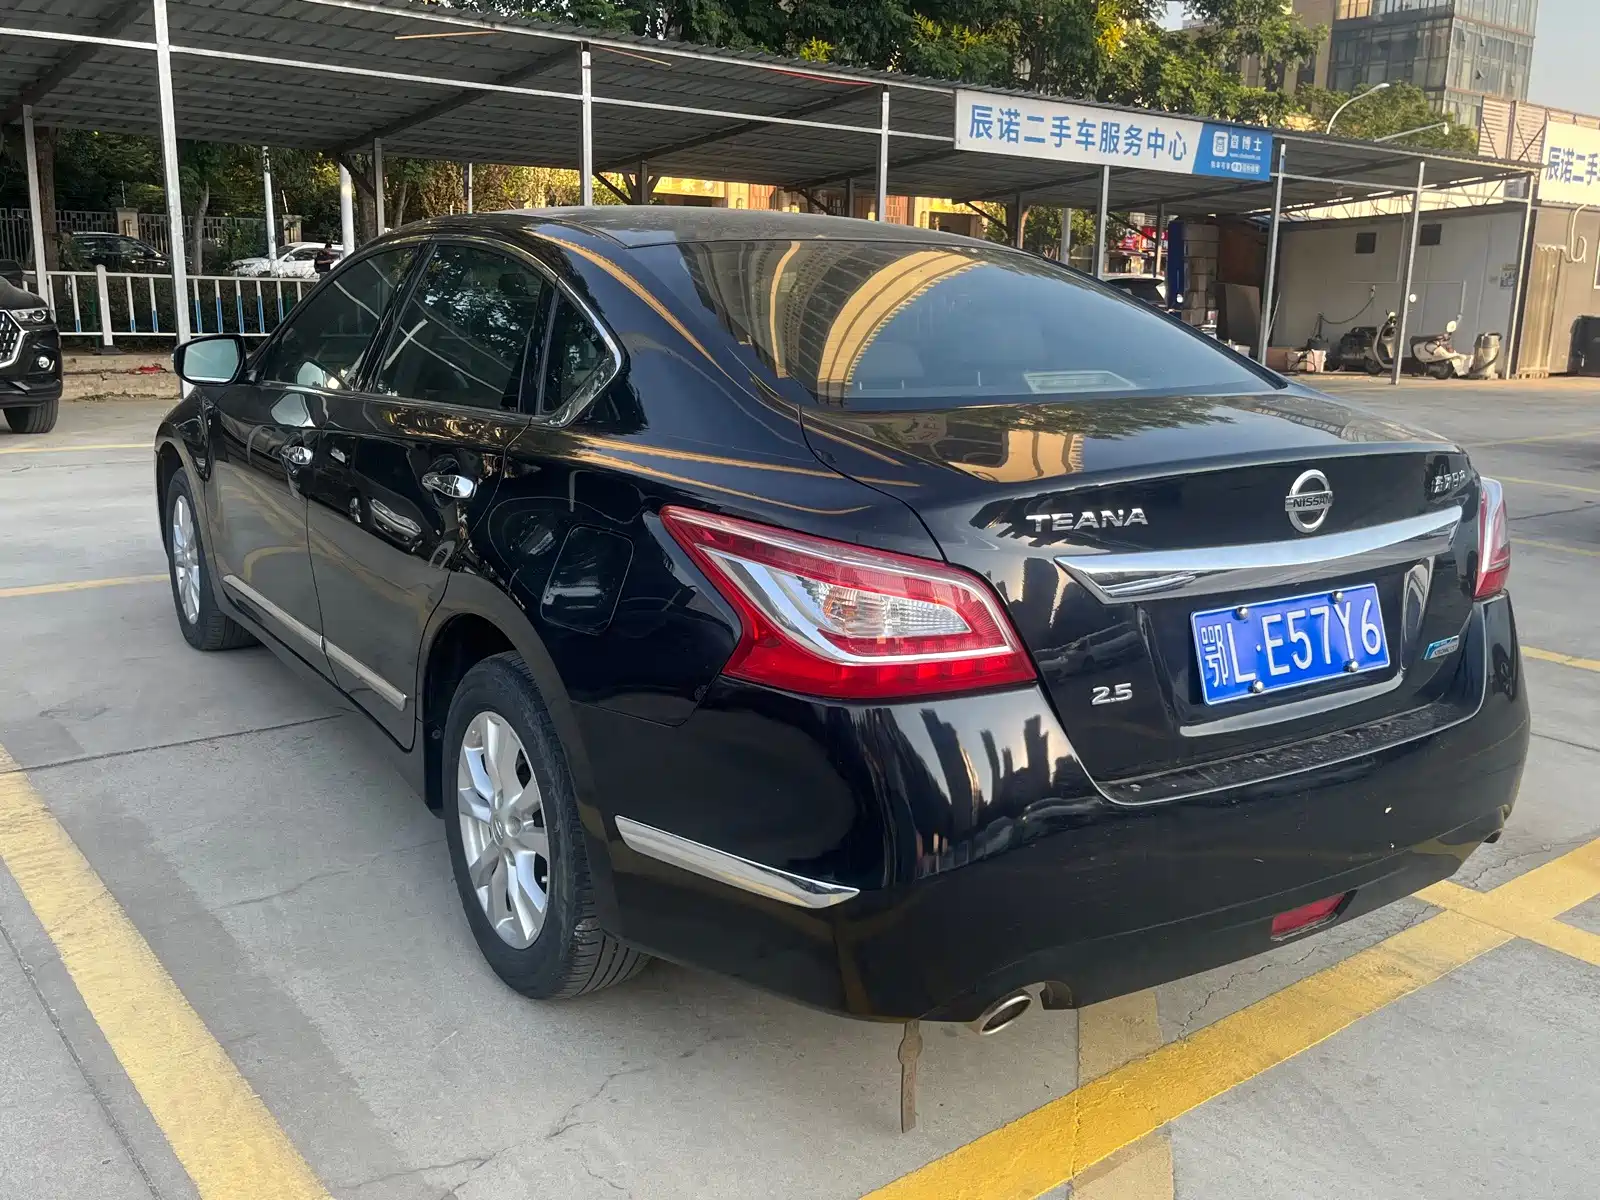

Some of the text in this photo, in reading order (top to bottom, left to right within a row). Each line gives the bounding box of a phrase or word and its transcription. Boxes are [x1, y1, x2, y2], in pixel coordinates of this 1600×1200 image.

[968, 104, 1188, 162] 辰诺二手车服务中心
[1545, 146, 1600, 186] 辰诺二手
[1292, 493, 1331, 508] NISSAN
[1025, 507, 1149, 533] TEANA
[1091, 682, 1133, 705] 2.5
